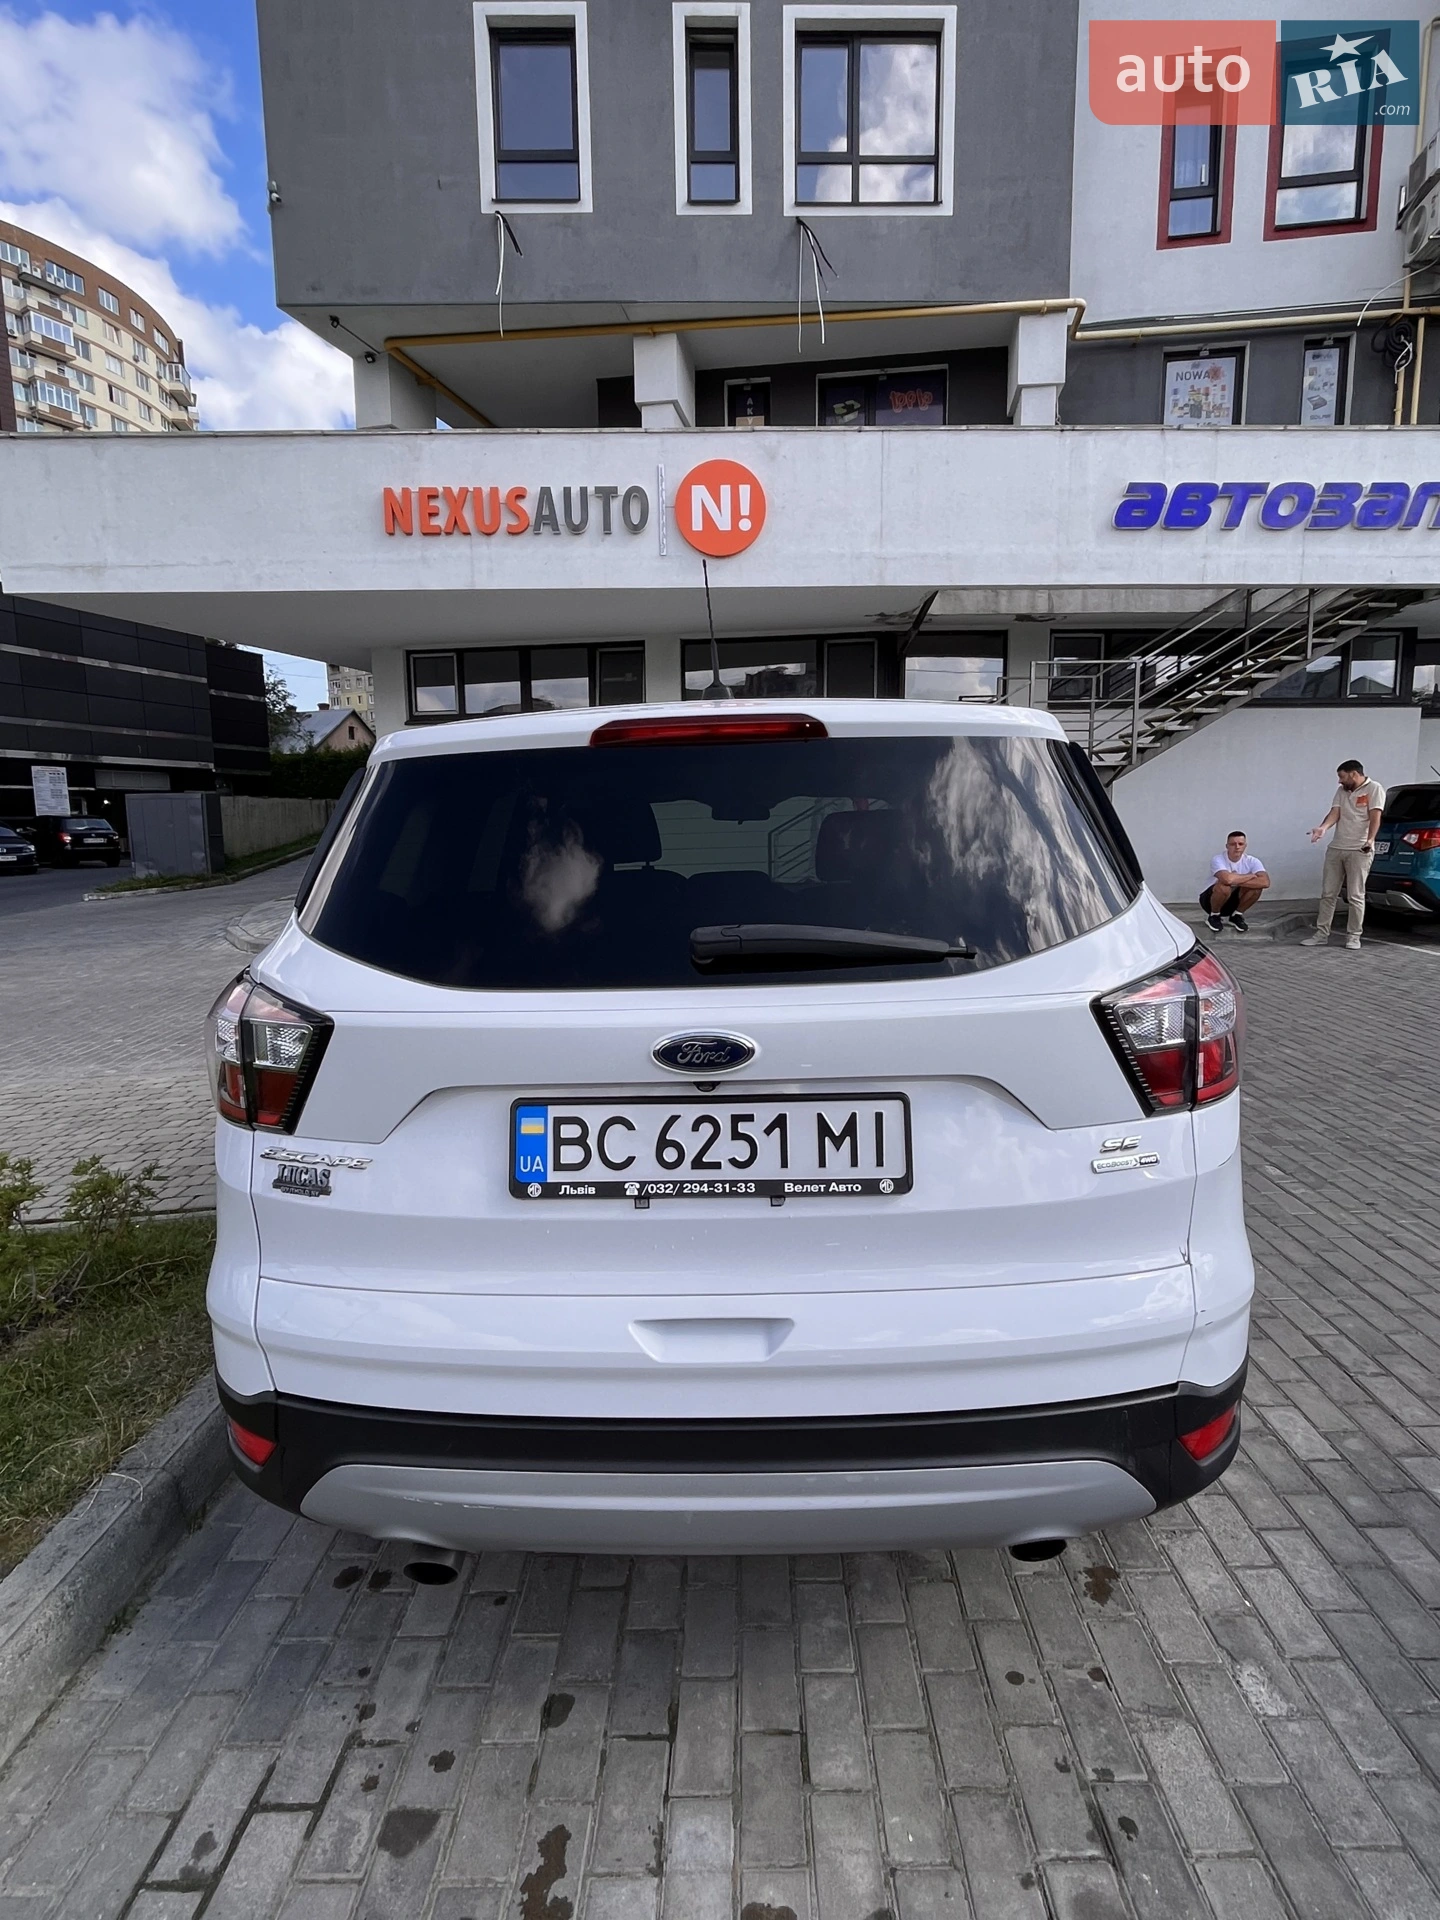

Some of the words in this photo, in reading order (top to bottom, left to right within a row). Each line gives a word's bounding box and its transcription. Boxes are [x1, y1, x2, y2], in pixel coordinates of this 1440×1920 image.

[382, 485, 650, 536] NEXUSAUTO
[690, 484, 751, 532] N!
[677, 1041, 731, 1064] Ford
[553, 1115, 637, 1171] BC
[655, 1113, 789, 1171] 6251
[816, 1111, 884, 1169] MI
[1100, 1136, 1142, 1153] SE
[260, 1146, 373, 1170] ESCAPE
[520, 1155, 544, 1173] UA
[277, 1164, 331, 1187] LUCAS
[559, 1185, 596, 1195] Львів
[641, 1183, 680, 1196] /032/
[683, 1182, 756, 1194] 294-31-33
[784, 1182, 825, 1193] Велет
[829, 1182, 862, 1193] Авто
